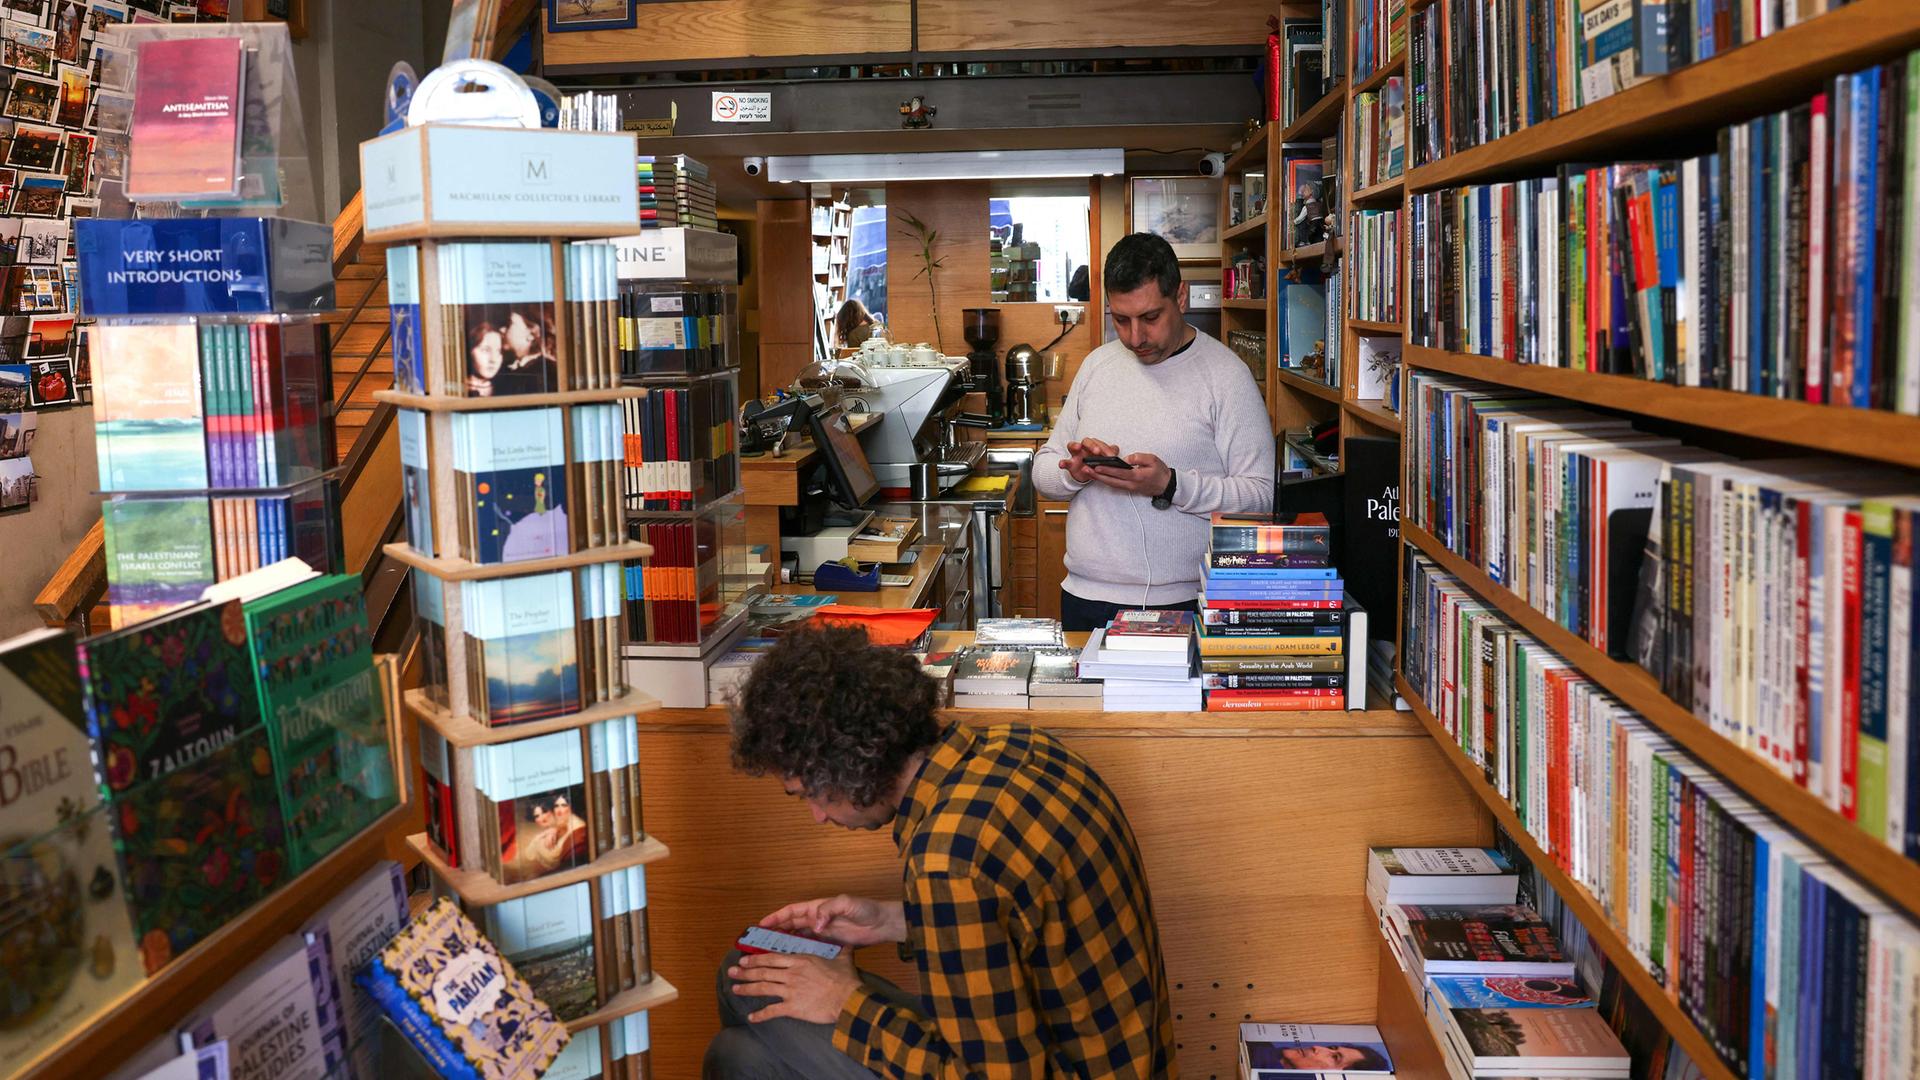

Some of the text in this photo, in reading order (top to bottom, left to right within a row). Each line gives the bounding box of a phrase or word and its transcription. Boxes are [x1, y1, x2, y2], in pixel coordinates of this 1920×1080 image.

[1586, 4, 1620, 31] SIX DAYS
[162, 102, 229, 112] ANTISEMITISM
[527, 160, 548, 180] M
[515, 193, 580, 202] COLLECTOR'S
[584, 195, 621, 203] LIBRARY
[124, 249, 223, 262] VERY SHORT
[108, 269, 242, 283] INTRODUCTIONS
[117, 552, 134, 560] THE
[1671, 480, 1679, 610] GAZA UNDER HAMAS
[1684, 482, 1692, 616] GAZA UNDER HAMAS
[121, 561, 202, 570] ISRAELI CONFLICT
[1218, 555, 1247, 566] Harry Potter
[1844, 524, 1857, 594] BREXIT
[149, 724, 238, 780] ZAITOUN
[1434, 849, 1459, 872] DELUSION
[1450, 848, 1478, 874] TWO-STATE
[346, 914, 385, 958] JOURNAL OF
[342, 922, 396, 980] PALESTINE
[443, 978, 460, 992] THE
[449, 963, 497, 1014] PARISIAN
[239, 1002, 296, 1056] JOURNAL OF
[402, 1018, 417, 1033] THE
[232, 1010, 312, 1080] PALESTINE
